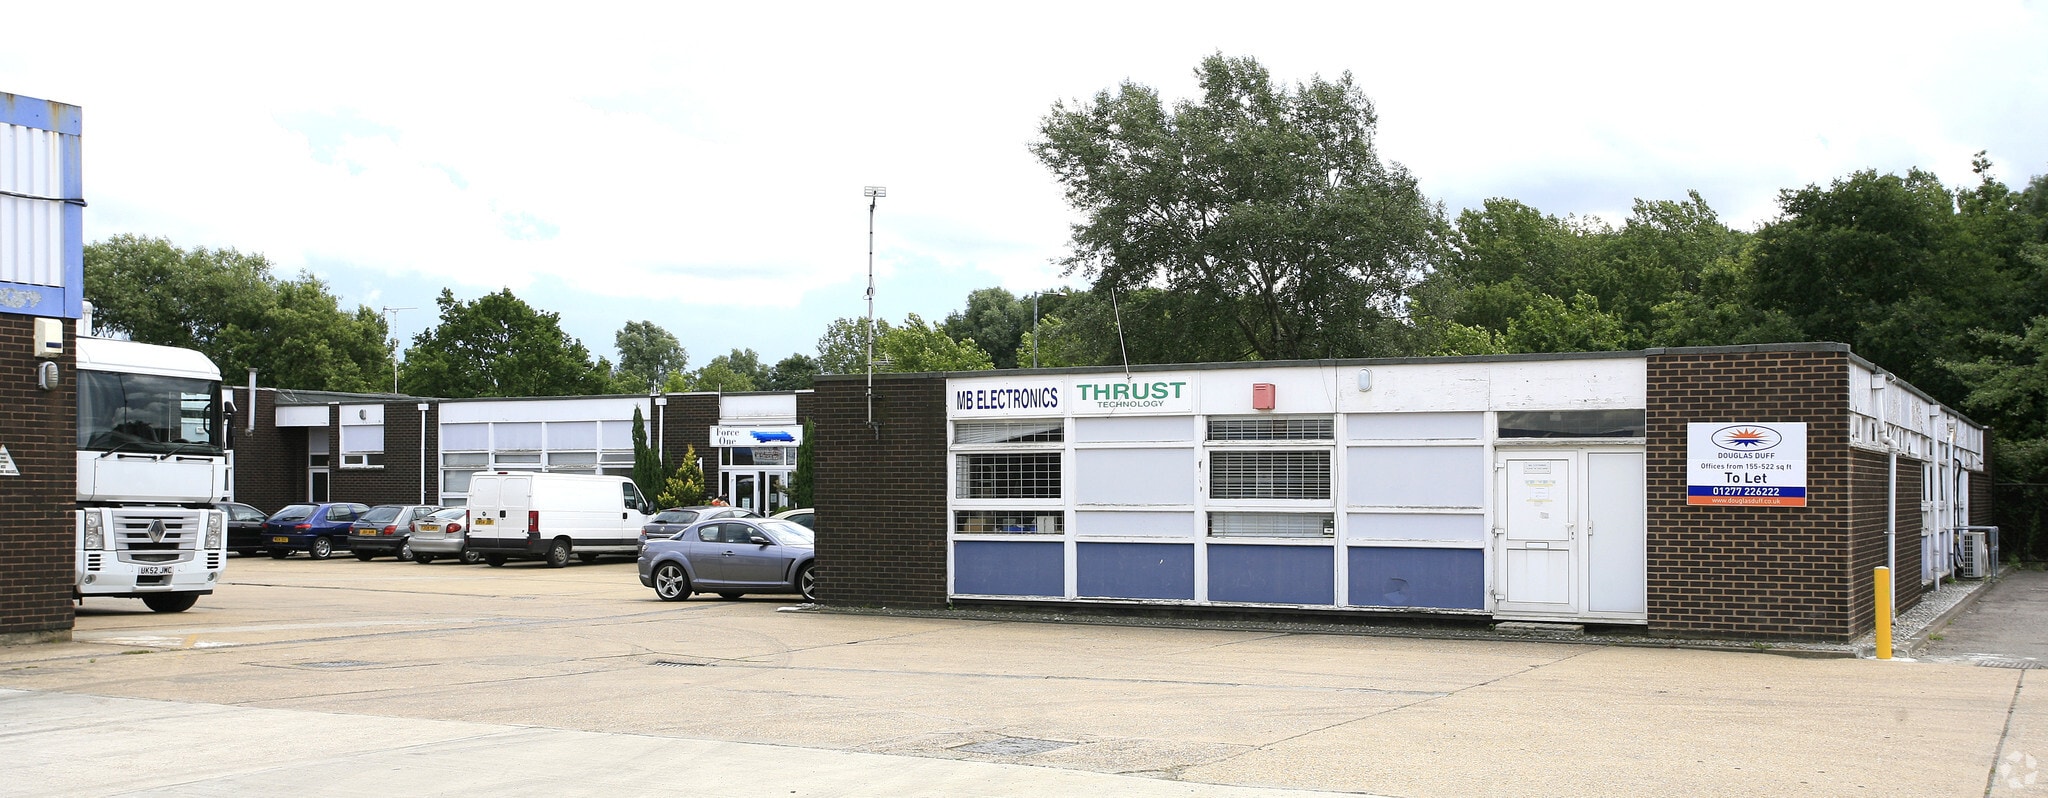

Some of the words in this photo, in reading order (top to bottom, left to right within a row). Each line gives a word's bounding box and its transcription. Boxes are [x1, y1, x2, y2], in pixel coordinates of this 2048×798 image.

[1076, 381, 1187, 401] THRUST
[957, 390, 973, 410] MB
[977, 387, 1058, 409] ELECTRONICS
[1097, 400, 1164, 409] TECHNOLOGY
[716, 428, 739, 436] Force
[719, 437, 737, 445] One
[1725, 472, 1740, 483] To
[1745, 472, 1767, 483] Let
[1713, 487, 1742, 496] 01277
[1744, 488, 1779, 496] 226222
